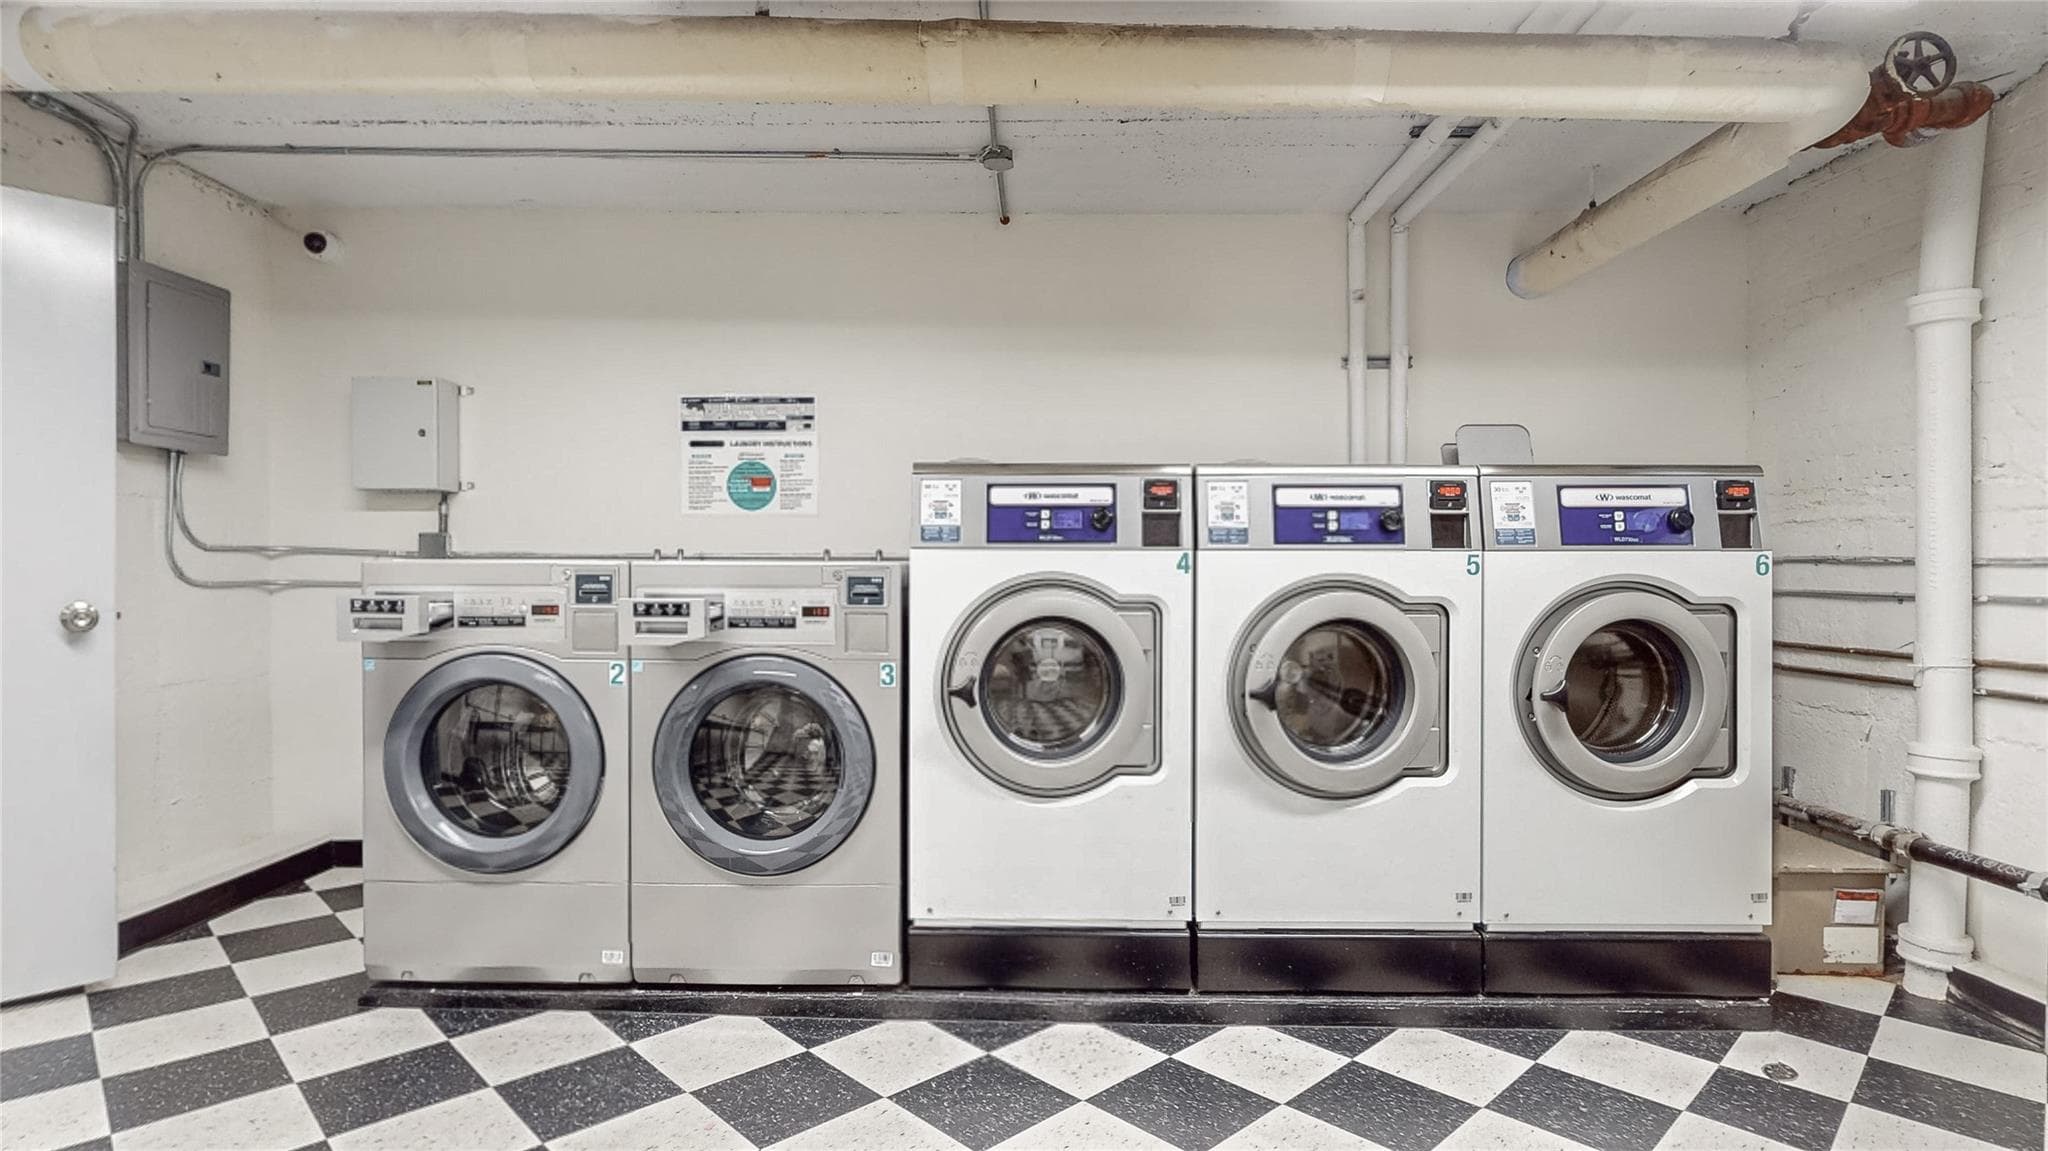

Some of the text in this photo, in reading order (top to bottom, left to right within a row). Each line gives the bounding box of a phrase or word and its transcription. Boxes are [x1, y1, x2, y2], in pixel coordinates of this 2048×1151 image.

[1176, 552, 1190, 574] 4
[1466, 554, 1480, 576] 5
[1755, 553, 1770, 577] 6
[610, 663, 624, 685] 2
[881, 663, 894, 686] 3
[1997, 862, 2026, 878] USA
